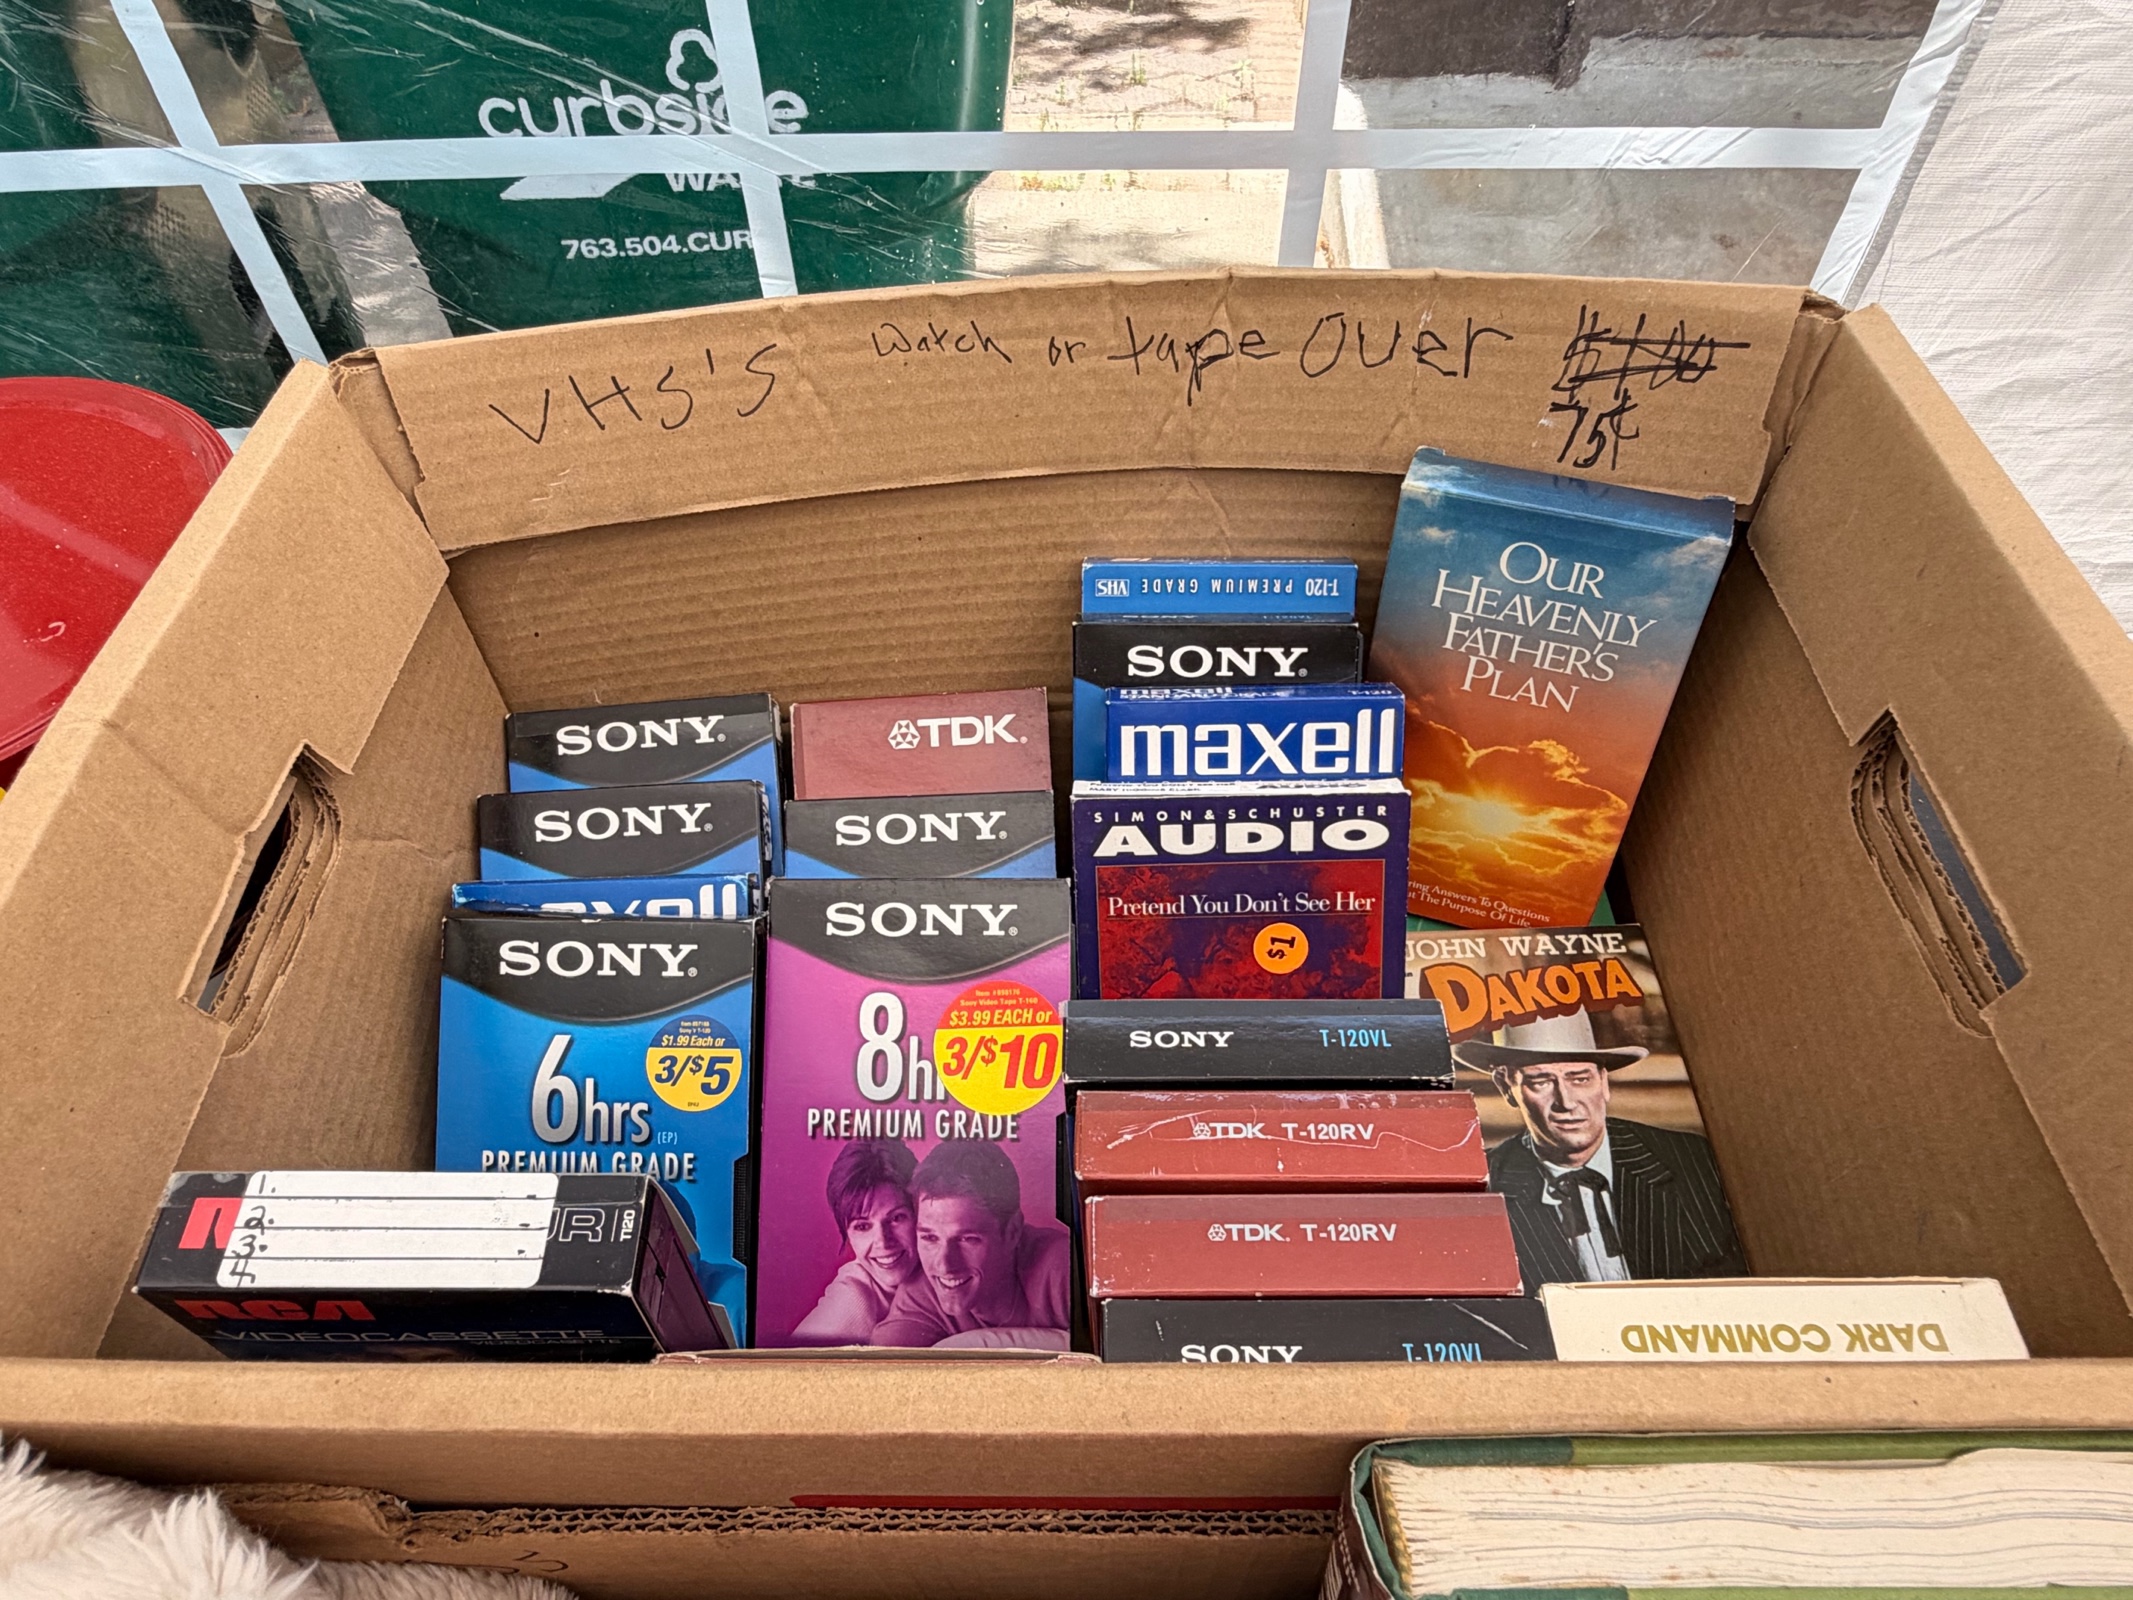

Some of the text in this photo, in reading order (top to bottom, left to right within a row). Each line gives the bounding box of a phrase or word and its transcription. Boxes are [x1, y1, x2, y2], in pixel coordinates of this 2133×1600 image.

[478, 79, 810, 137] curbsie
[1048, 336, 1087, 366] or
[1107, 315, 1281, 407] tape
[1549, 388, 1640, 471] 75¢
[1141, 578, 1339, 596] T-120 PREMIUM GRADE
[1499, 541, 1606, 599] OUR
[1096, 579, 1129, 596] VHS
[1431, 568, 1658, 648] HEAVENLY
[1127, 645, 1308, 679] SONY
[1441, 611, 1620, 682] FATHER'S
[1460, 655, 1580, 713] PLAN
[555, 715, 725, 757] SONY
[916, 713, 1020, 748] TDK
[1120, 708, 1396, 777] maxell
[534, 802, 712, 842] SONY
[835, 811, 1007, 846] SONY
[1092, 819, 1390, 857] AUDIO
[1107, 891, 1376, 917] Pretend You Don't See Her
[1408, 880, 1551, 922] ring Answers To Questions
[1417, 891, 1441, 905] The
[1441, 898, 1487, 917] Purpose
[1490, 910, 1506, 922] Of
[825, 902, 1018, 938] SONY
[499, 940, 699, 978] SONY
[1266, 935, 1297, 961] $1
[1405, 932, 1628, 961] JOHN WAYNE
[1424, 957, 1643, 1034] DAKOTA
[949, 1008, 1053, 1027] $3.99 EACH or
[661, 1034, 726, 1047] $1.99 Each or
[1129, 1029, 1392, 1048] SONY T-120VL
[942, 1032, 1059, 1090] 3/$10
[657, 1131, 678, 1145] (EP)
[807, 1108, 1018, 1139] PREMIUM GRADE
[1209, 1122, 1374, 1140] TDK T-120RV
[481, 1150, 695, 1181] PREMIUM GRADE
[1224, 1223, 1397, 1242] TDK T-120RV
[215, 1329, 605, 1342] VIDEOCASSETTE
[1620, 1322, 1950, 1353] DARK COMMAND
[1181, 1344, 1303, 1363] SONY
